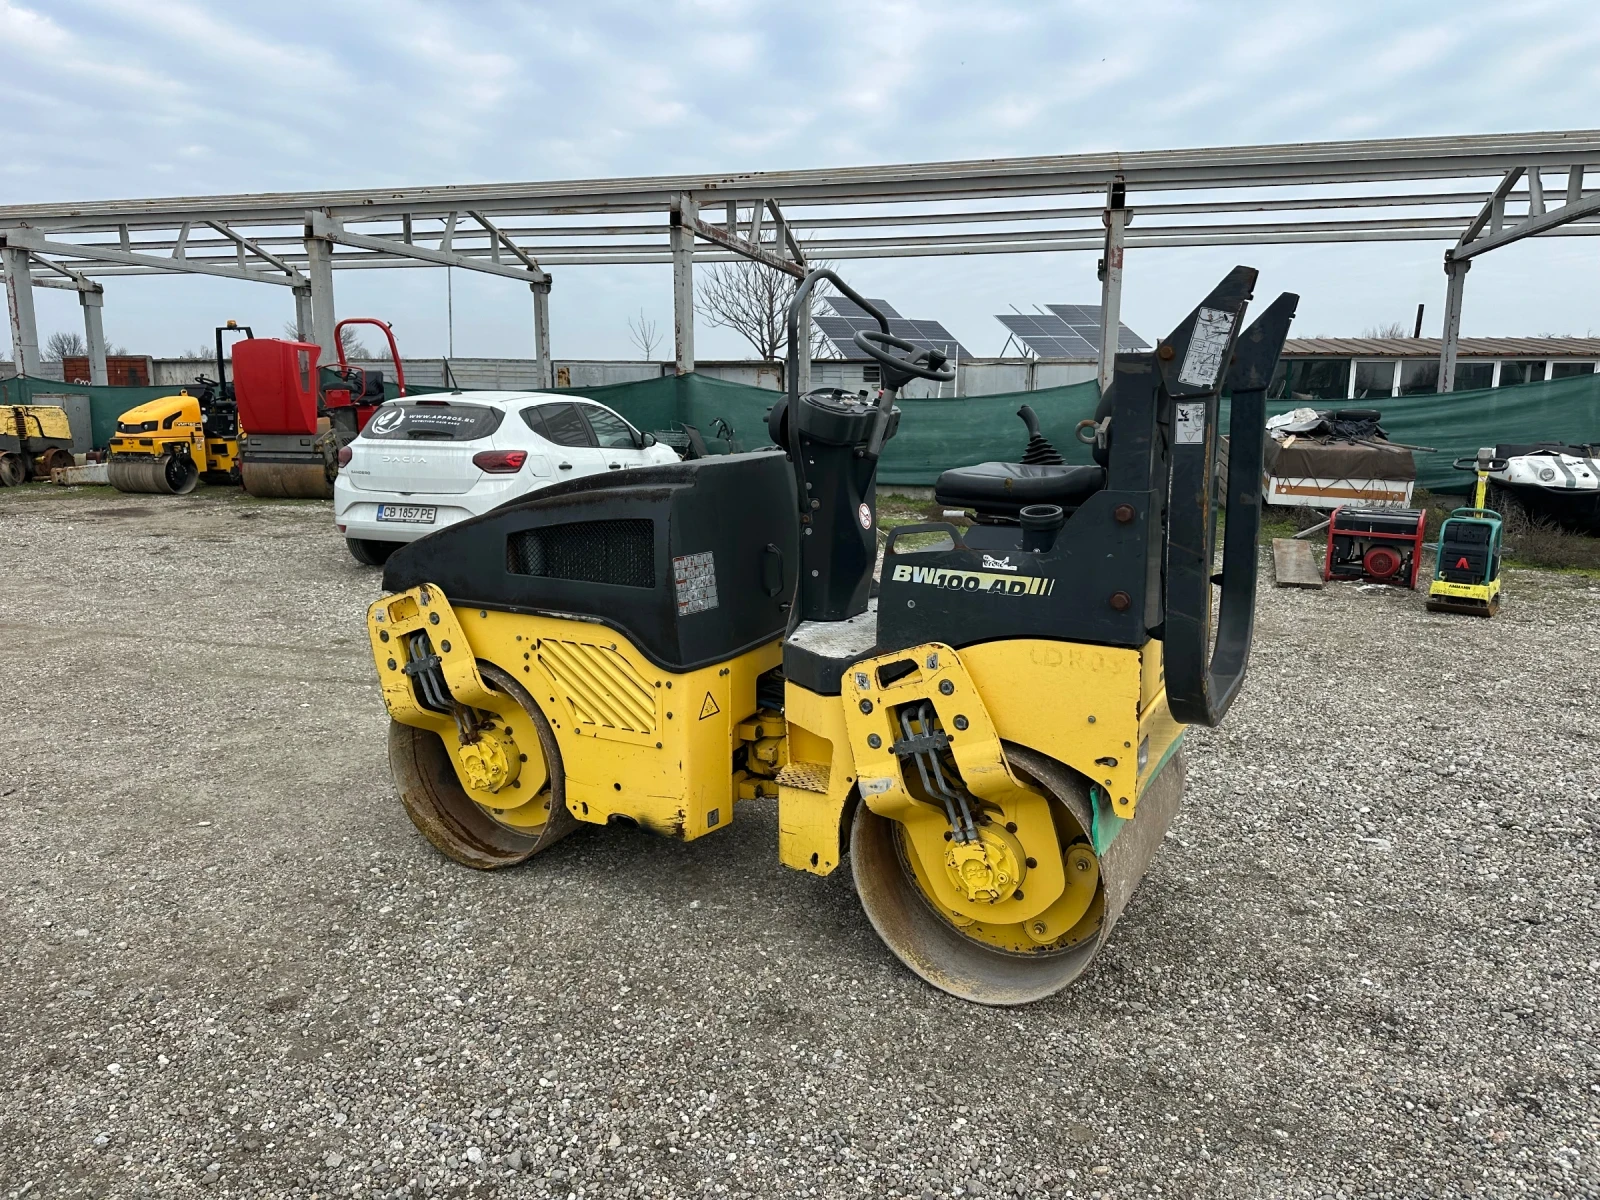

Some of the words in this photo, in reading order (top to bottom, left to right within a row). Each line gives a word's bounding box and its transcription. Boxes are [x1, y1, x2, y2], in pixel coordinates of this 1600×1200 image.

[409, 414, 475, 423] WWW.APPROS.BG
[384, 507, 396, 517] CB
[399, 507, 420, 518] 1857
[420, 508, 434, 519] PE
